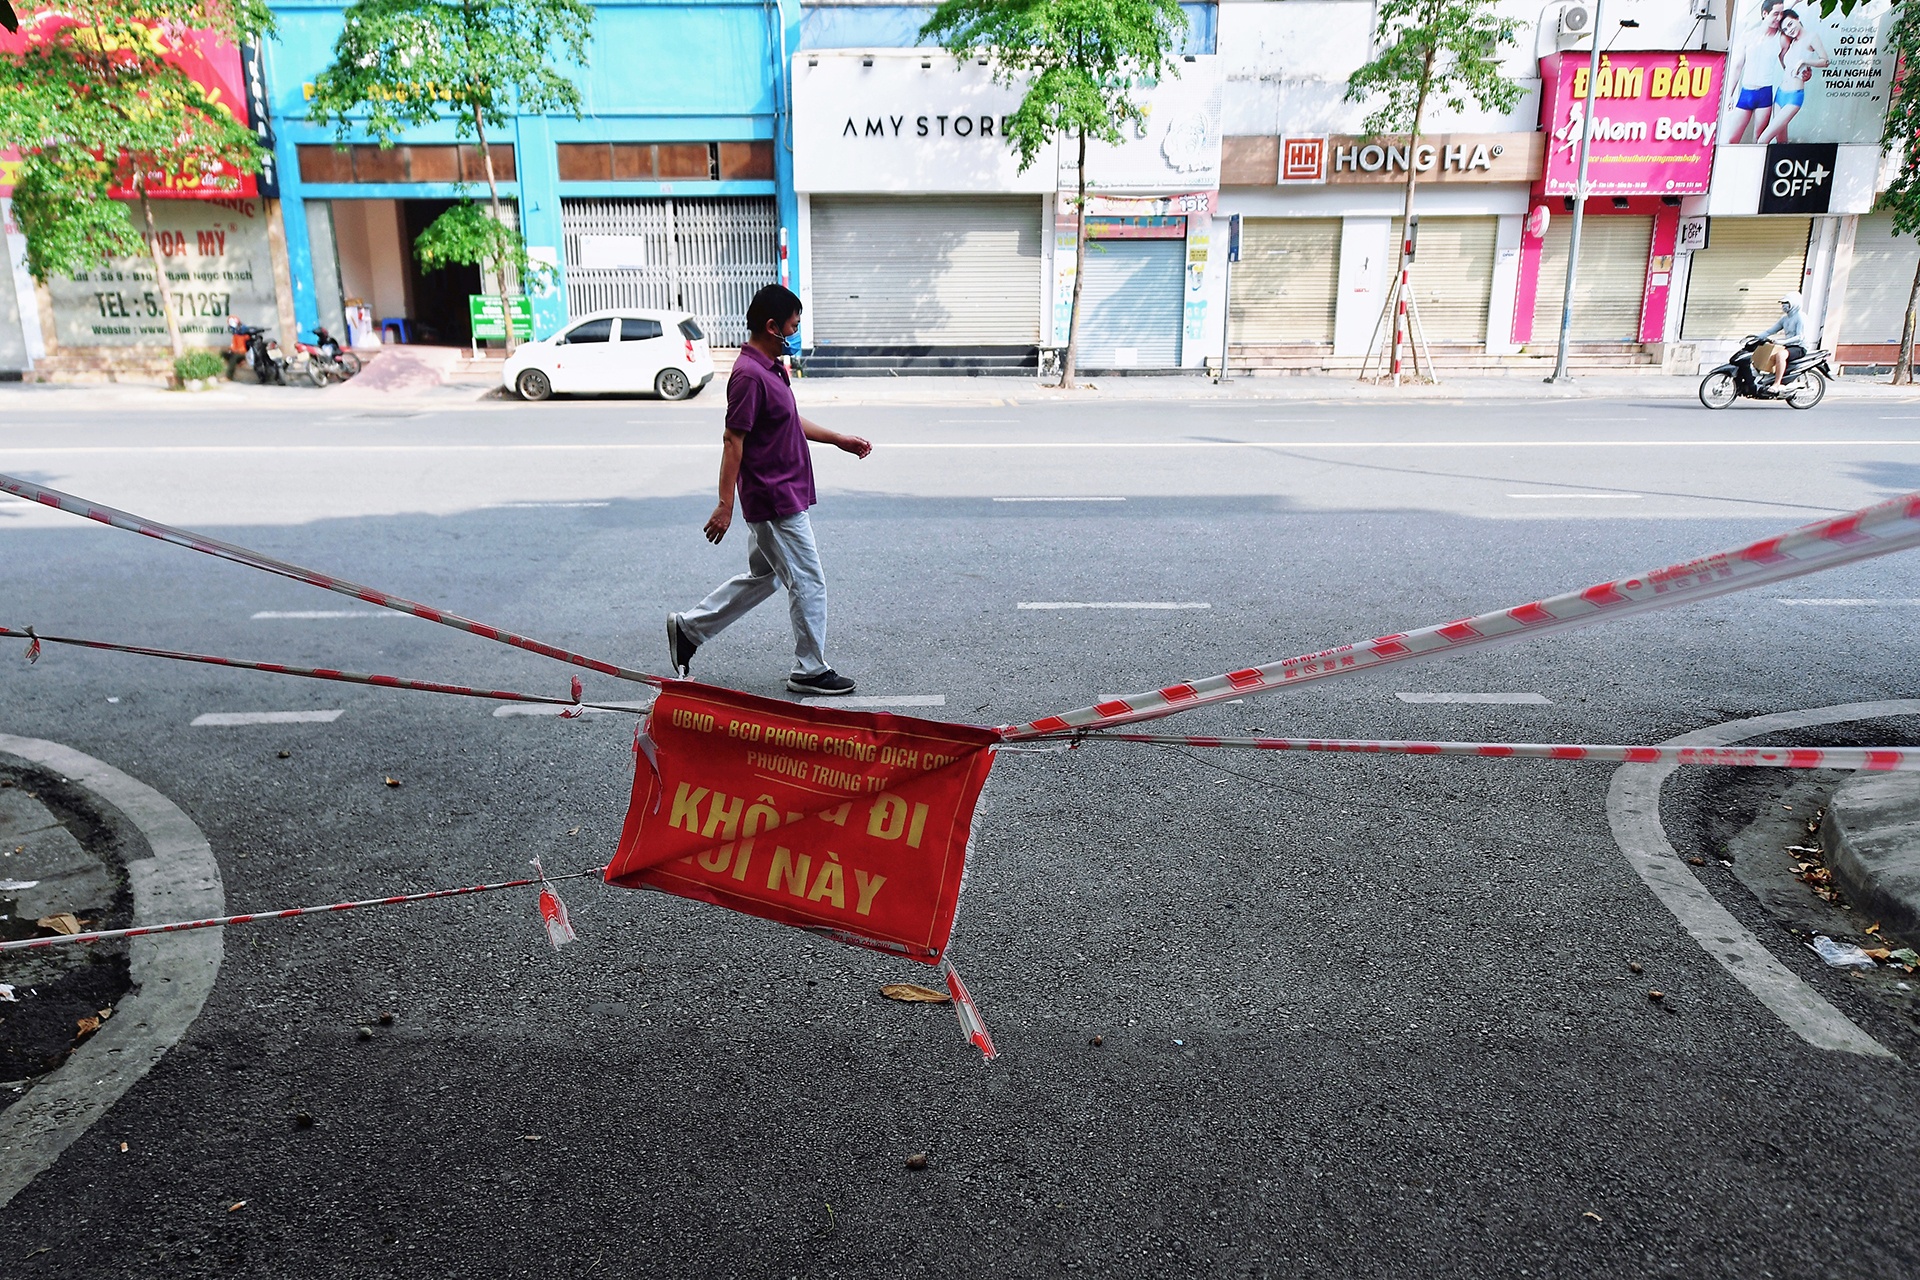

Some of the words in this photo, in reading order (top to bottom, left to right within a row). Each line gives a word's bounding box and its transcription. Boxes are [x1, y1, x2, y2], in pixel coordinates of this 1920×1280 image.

[1833, 46, 1853, 57] VIỆT
[1854, 48, 1877, 56] NAM
[1573, 55, 1644, 98] ĐẦM
[1651, 55, 1712, 98] BẦU
[843, 115, 903, 137] AMY
[1655, 115, 1717, 146] Baby
[1335, 144, 1436, 172] HONG
[1772, 178, 1814, 197] OFF
[94, 292, 131, 318] TEL
[672, 708, 714, 733] UBND
[765, 727, 818, 752] PHÒNG
[823, 735, 877, 763] CHỐNG
[880, 746, 918, 770] DỊCH
[812, 765, 861, 793] TRUNG
[866, 792, 929, 849] ĐI
[766, 845, 887, 916] NÀY
